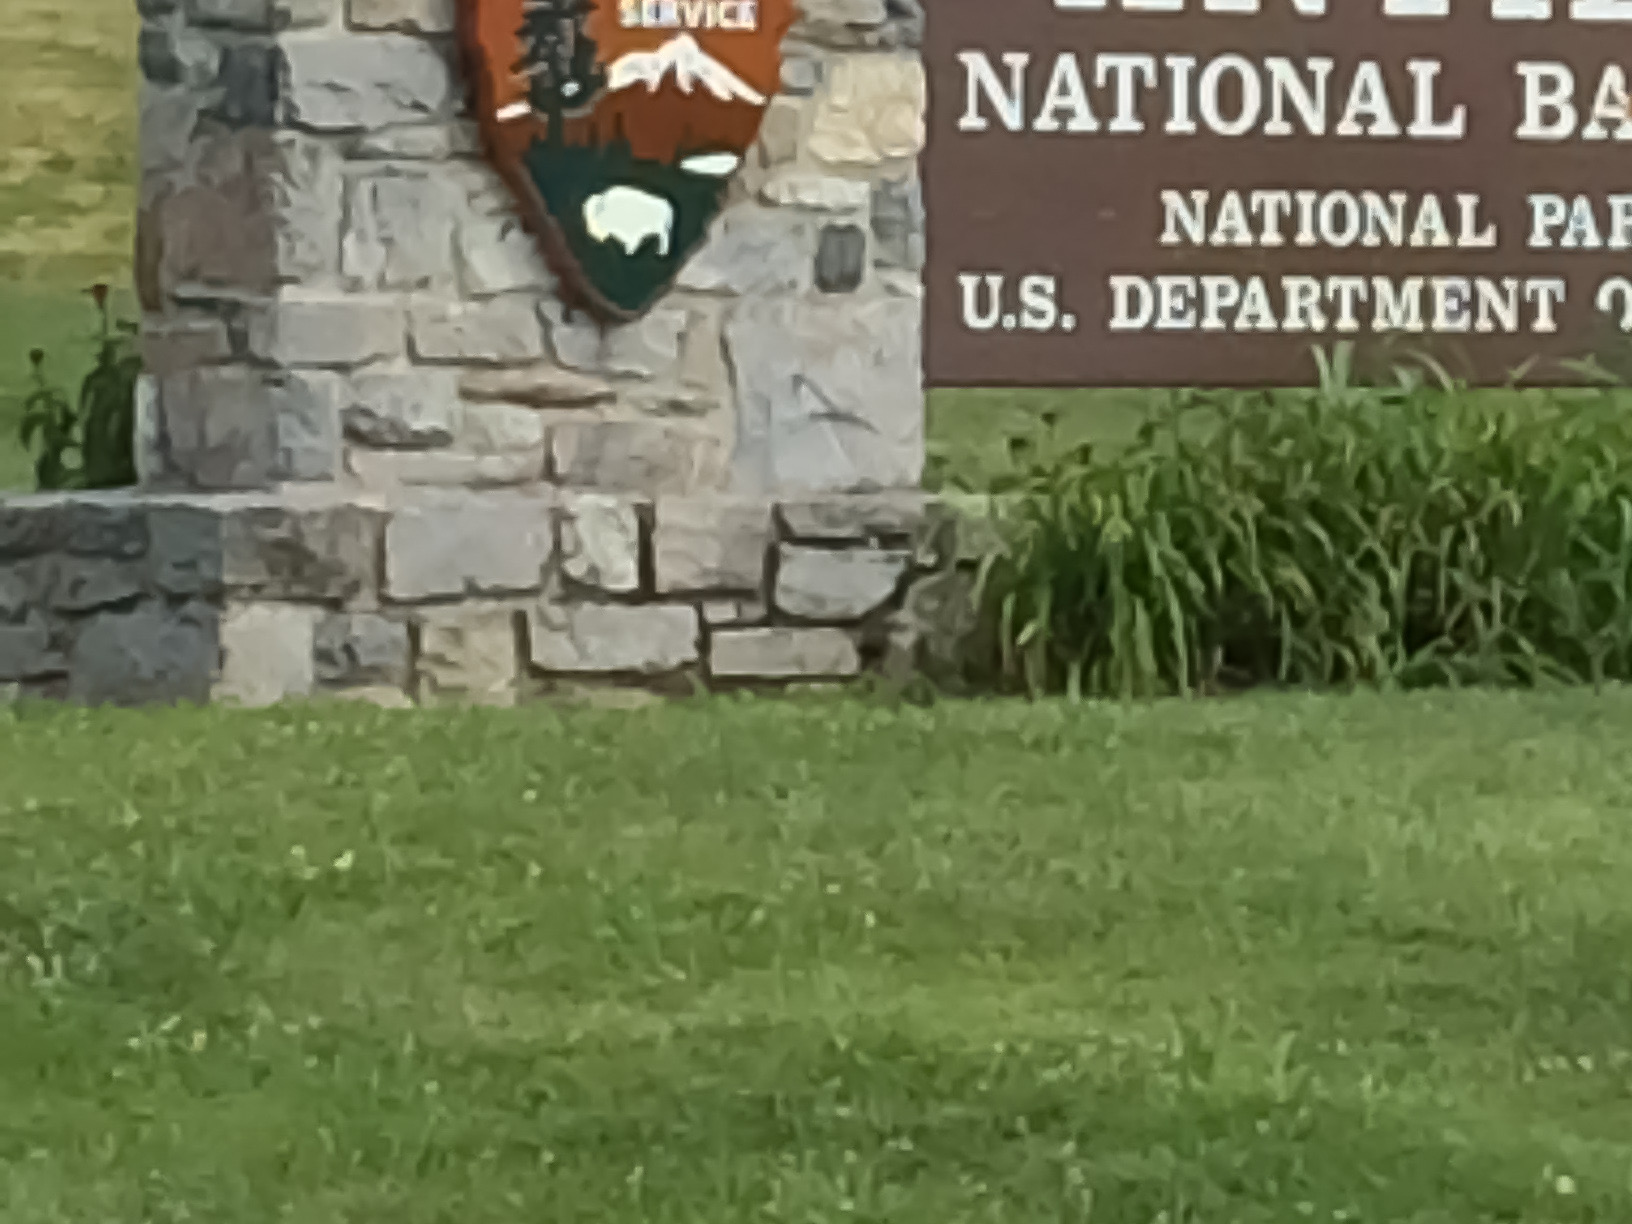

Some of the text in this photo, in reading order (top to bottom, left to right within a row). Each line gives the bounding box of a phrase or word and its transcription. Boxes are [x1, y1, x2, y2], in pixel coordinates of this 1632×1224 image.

[957, 51, 1468, 137] NATIONAL
[1160, 189, 1498, 248] NATIONAL
[957, 274, 1077, 331] U.S.
[1109, 275, 1566, 333] DEPARTMENT
